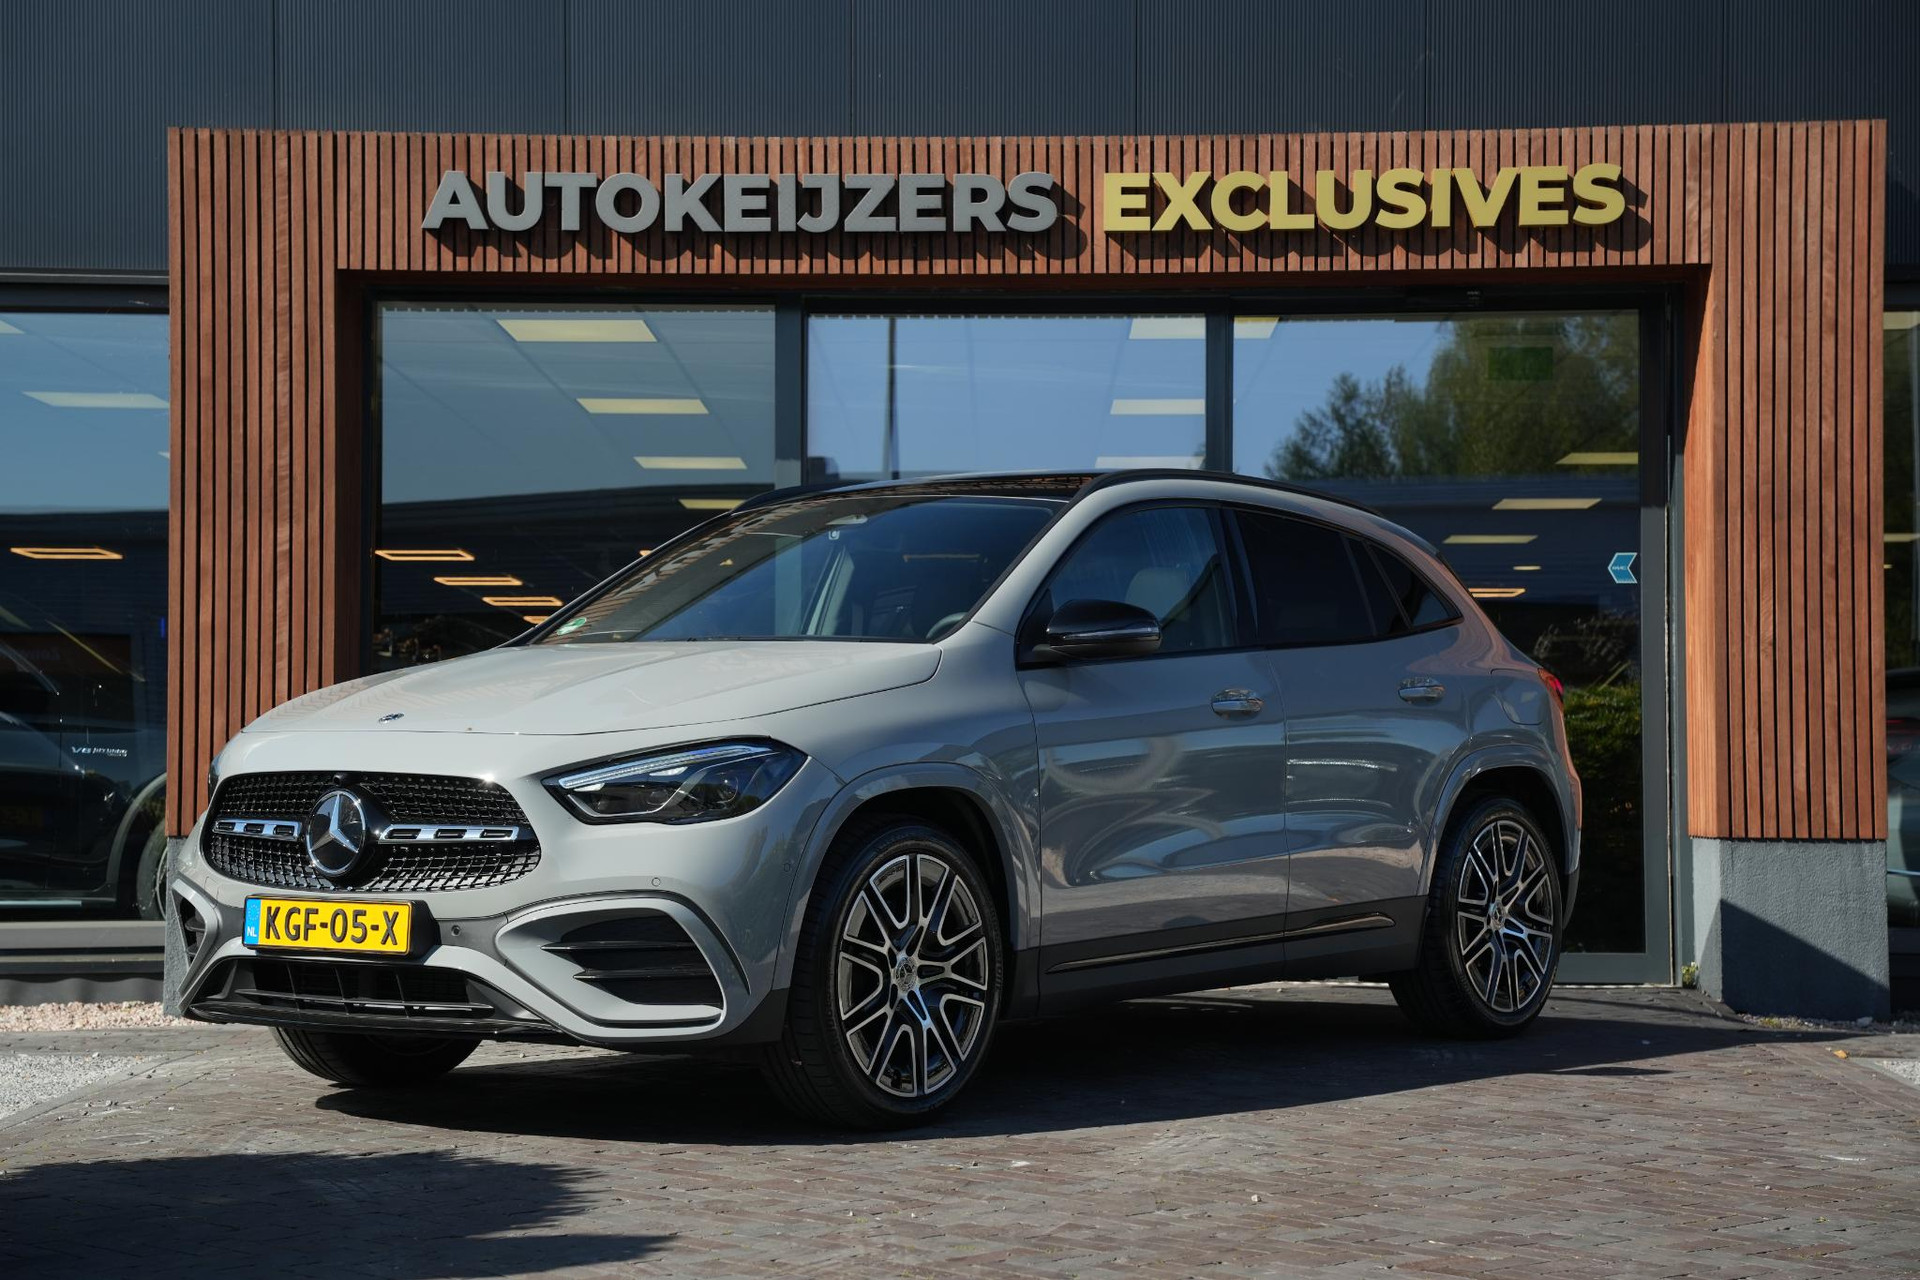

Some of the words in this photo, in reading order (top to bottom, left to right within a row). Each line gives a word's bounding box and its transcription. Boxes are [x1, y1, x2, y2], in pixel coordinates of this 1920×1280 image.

[421, 170, 1058, 234] AUTOKEIJZERS
[1103, 162, 1627, 232] EXCLUSIVES
[247, 926, 257, 938] NL
[265, 906, 399, 946] KGF-05-X
